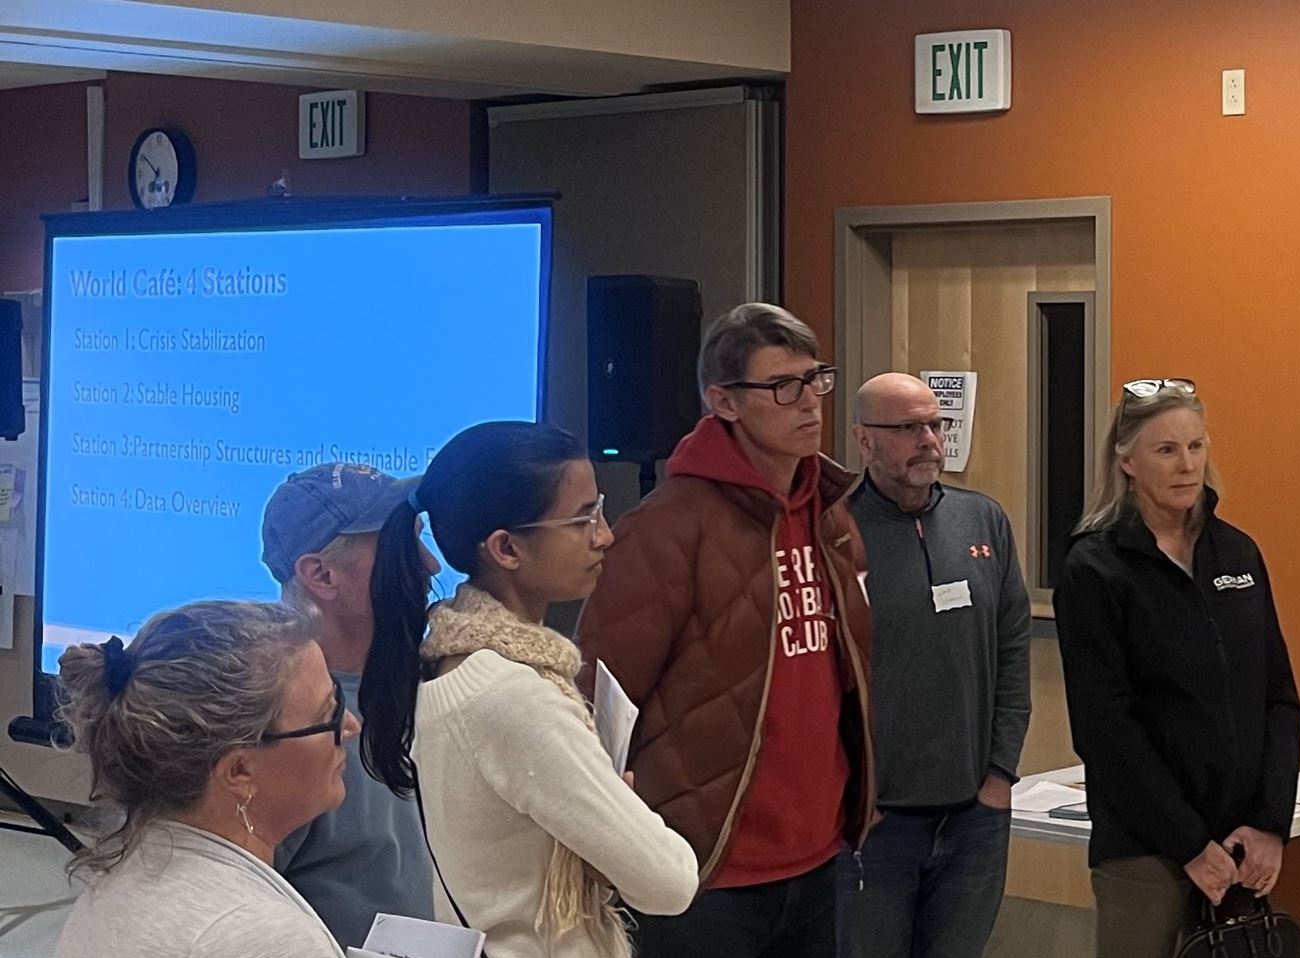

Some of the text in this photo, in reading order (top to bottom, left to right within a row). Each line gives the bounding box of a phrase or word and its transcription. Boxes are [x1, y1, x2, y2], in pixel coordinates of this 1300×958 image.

[932, 41, 988, 101] EXIT
[310, 99, 346, 148] EXIT
[70, 266, 287, 297] World Café: 4 Stations
[74, 328, 119, 350] Station
[138, 328, 176, 350] Crisis
[181, 328, 265, 351] Stabilization
[73, 381, 240, 413] Station 2: Stable Housing
[929, 377, 962, 389] NOTICE
[73, 433, 117, 456] Station
[216, 439, 292, 465] Structures
[296, 444, 324, 465] and
[330, 444, 418, 472] Sustainable
[72, 484, 240, 517] Station 4: Data Overview
[781, 620, 829, 657] CLUB
